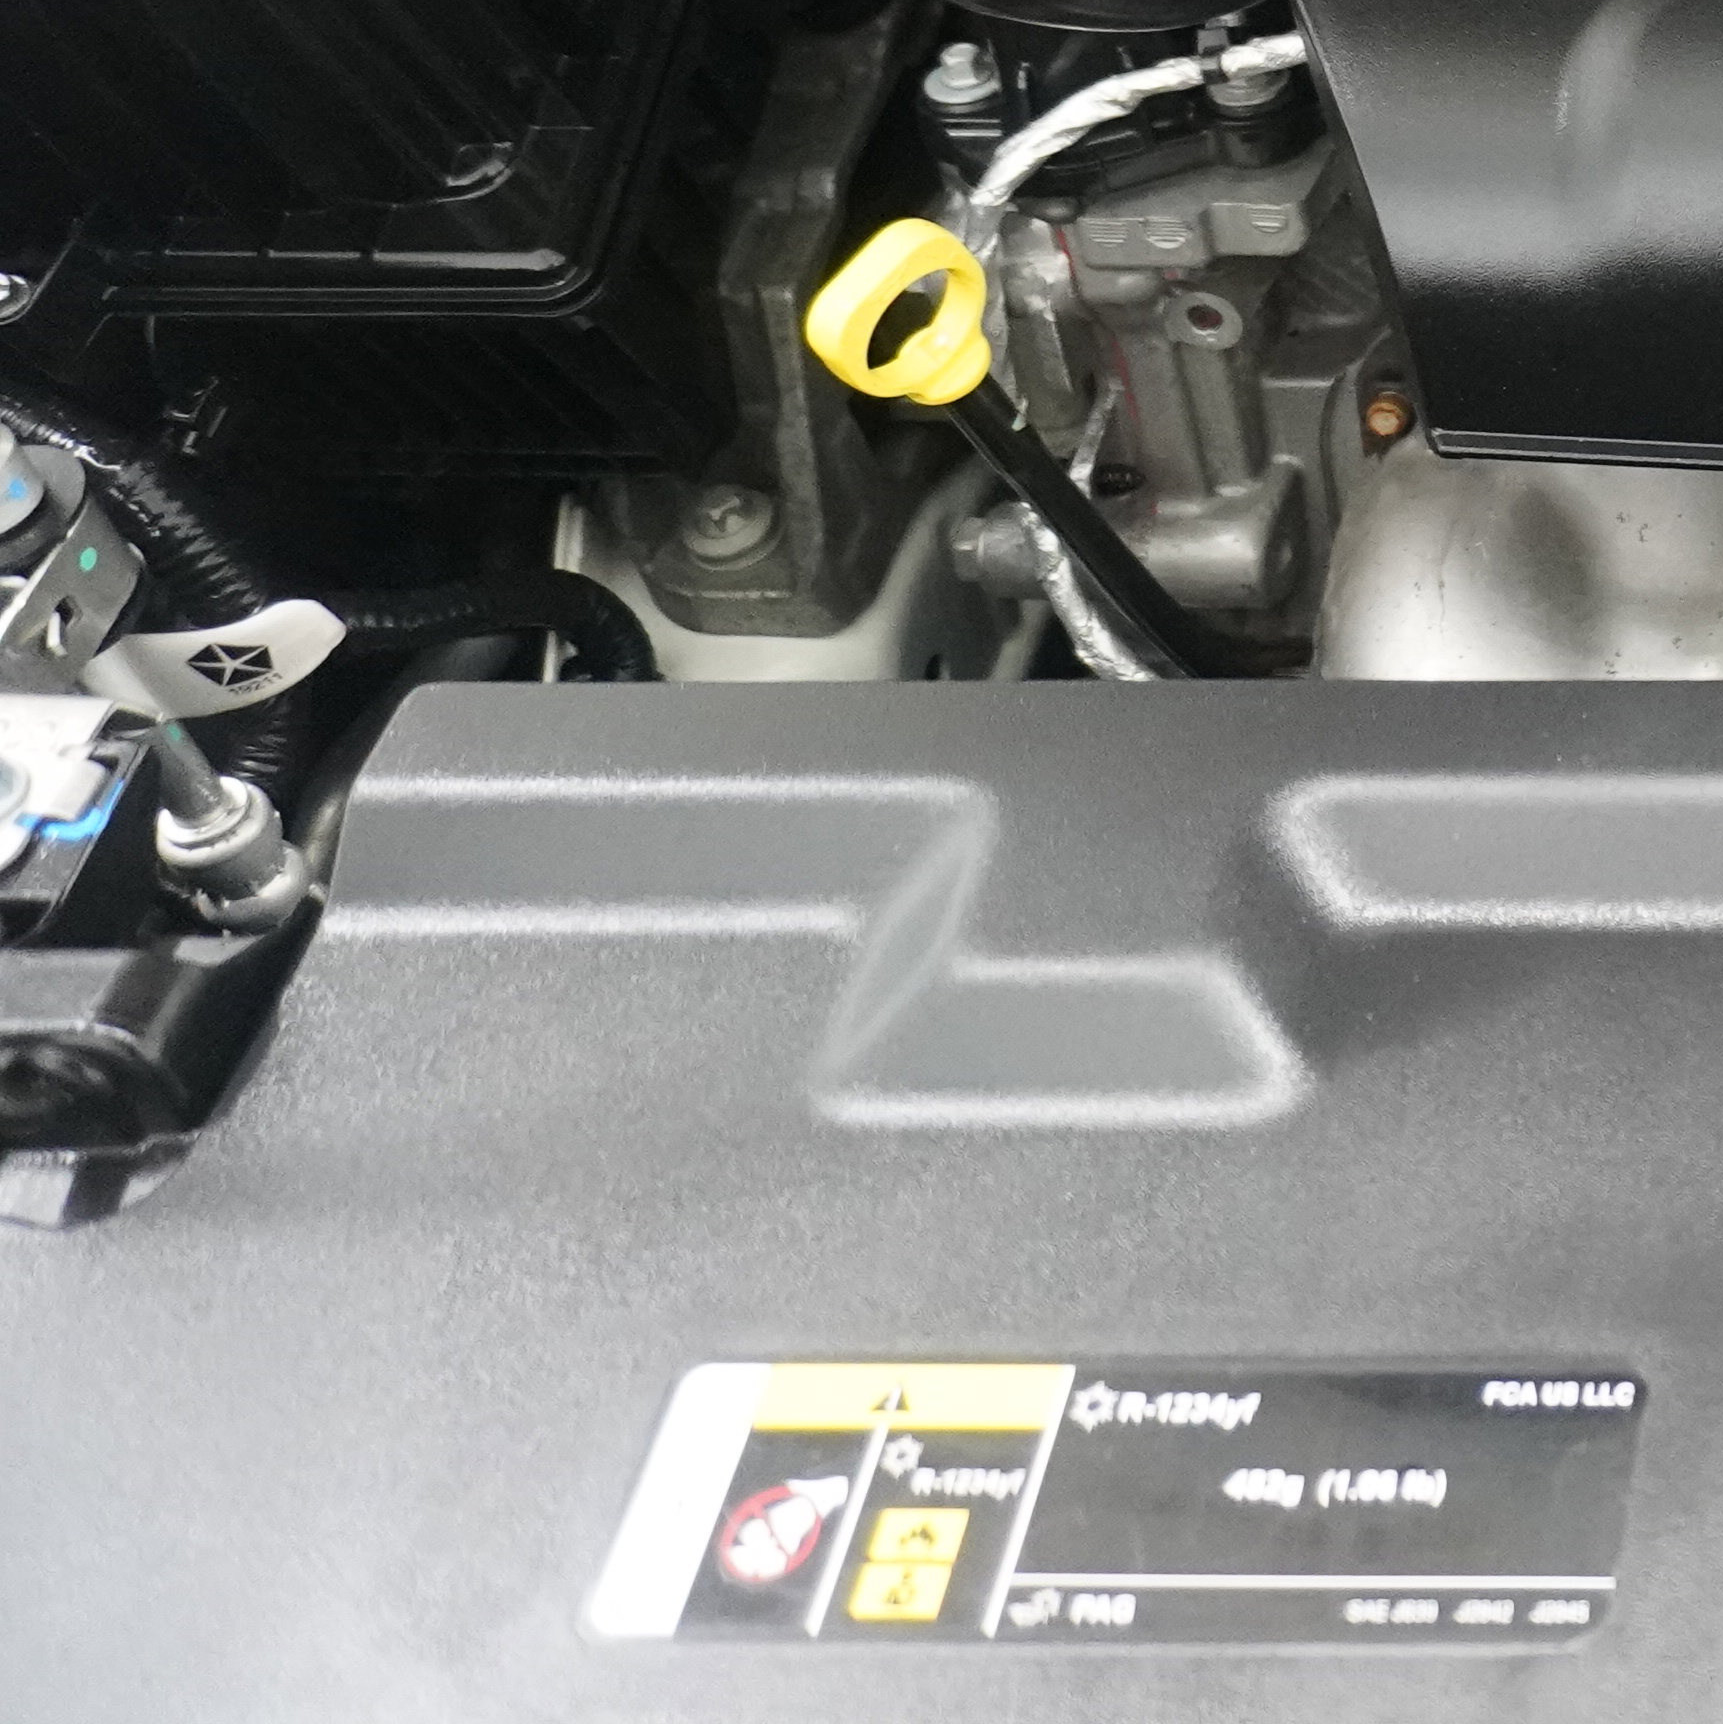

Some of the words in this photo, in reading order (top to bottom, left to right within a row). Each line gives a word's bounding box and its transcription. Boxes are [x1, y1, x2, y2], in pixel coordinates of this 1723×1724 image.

[1482, 1379, 1538, 1407] FCA
[1540, 1379, 1580, 1407] US
[1582, 1379, 1636, 1407] LLC
[1117, 1390, 1262, 1431] R-1234yf
